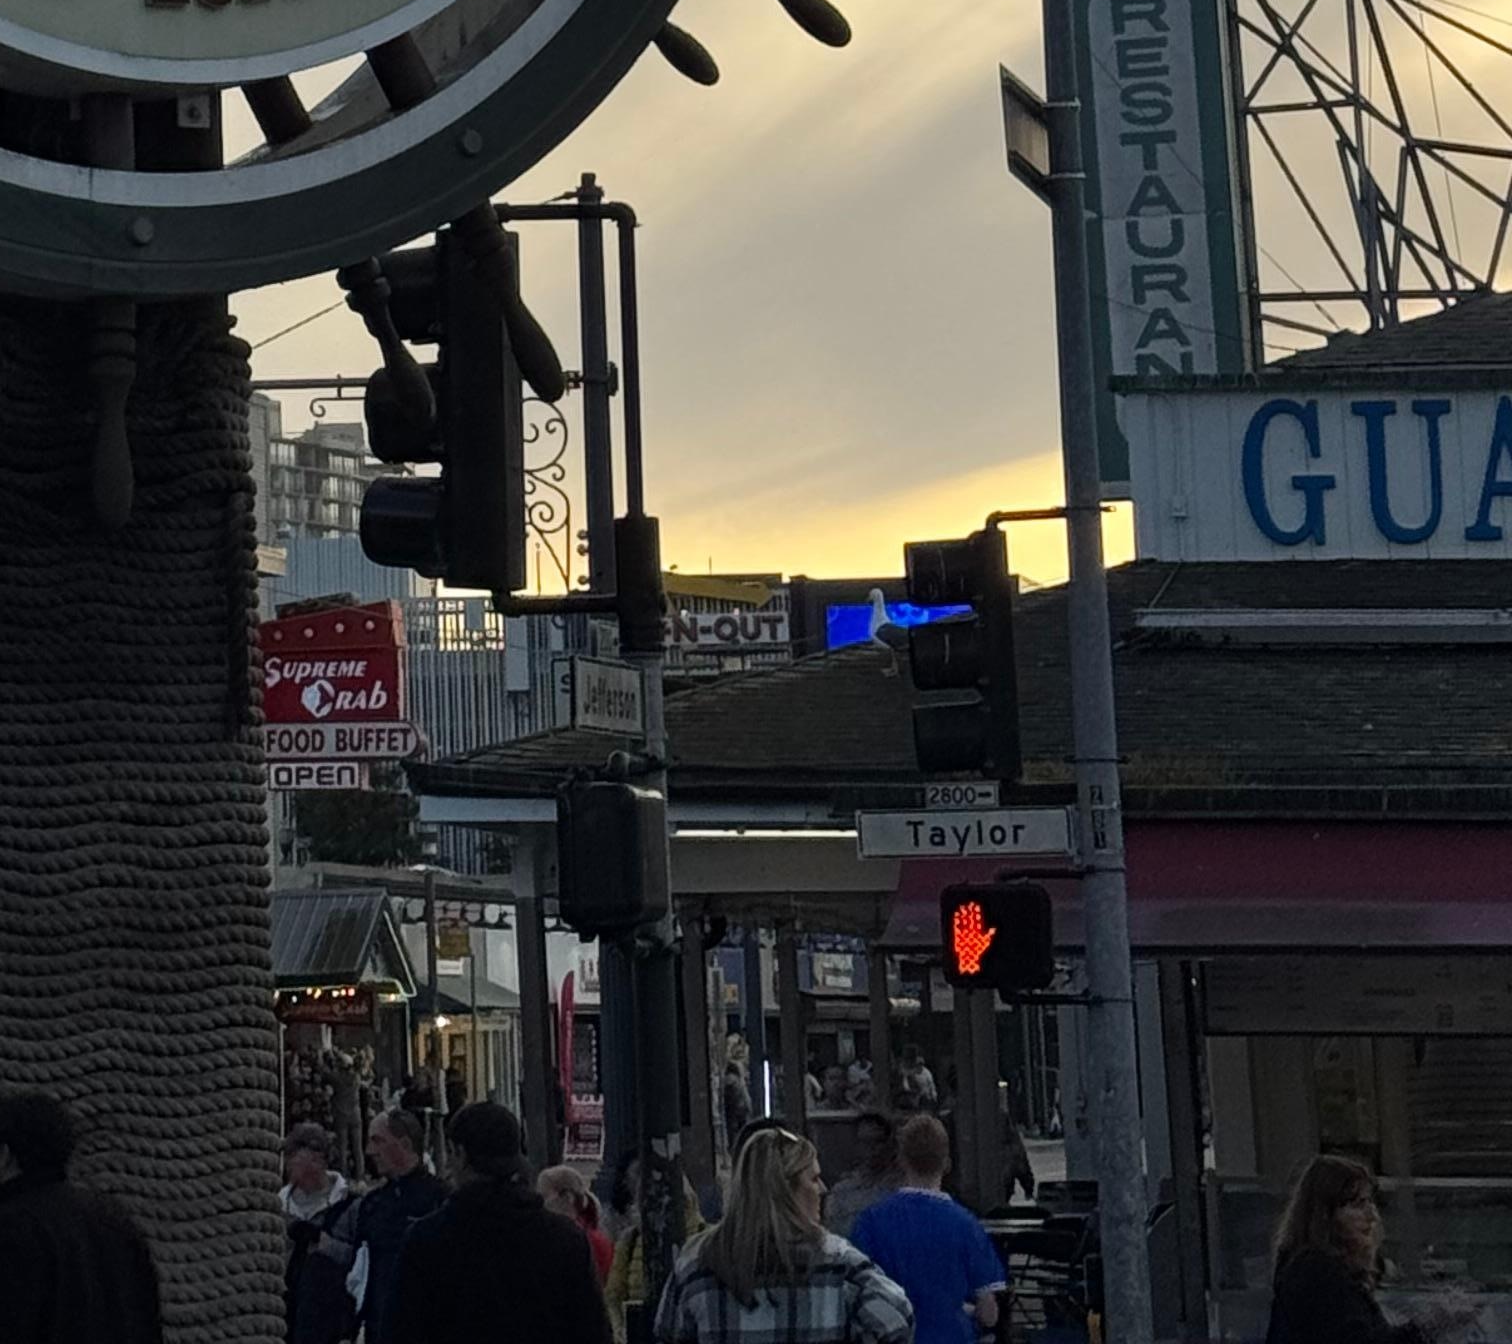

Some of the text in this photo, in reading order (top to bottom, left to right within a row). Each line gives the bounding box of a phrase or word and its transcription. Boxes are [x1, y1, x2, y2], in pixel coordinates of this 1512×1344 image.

[267, 728, 411, 752] FOOD BUFFET
[274, 765, 355, 786] OPEN
[929, 786, 976, 804] 2800
[906, 820, 1025, 852] Taylor
